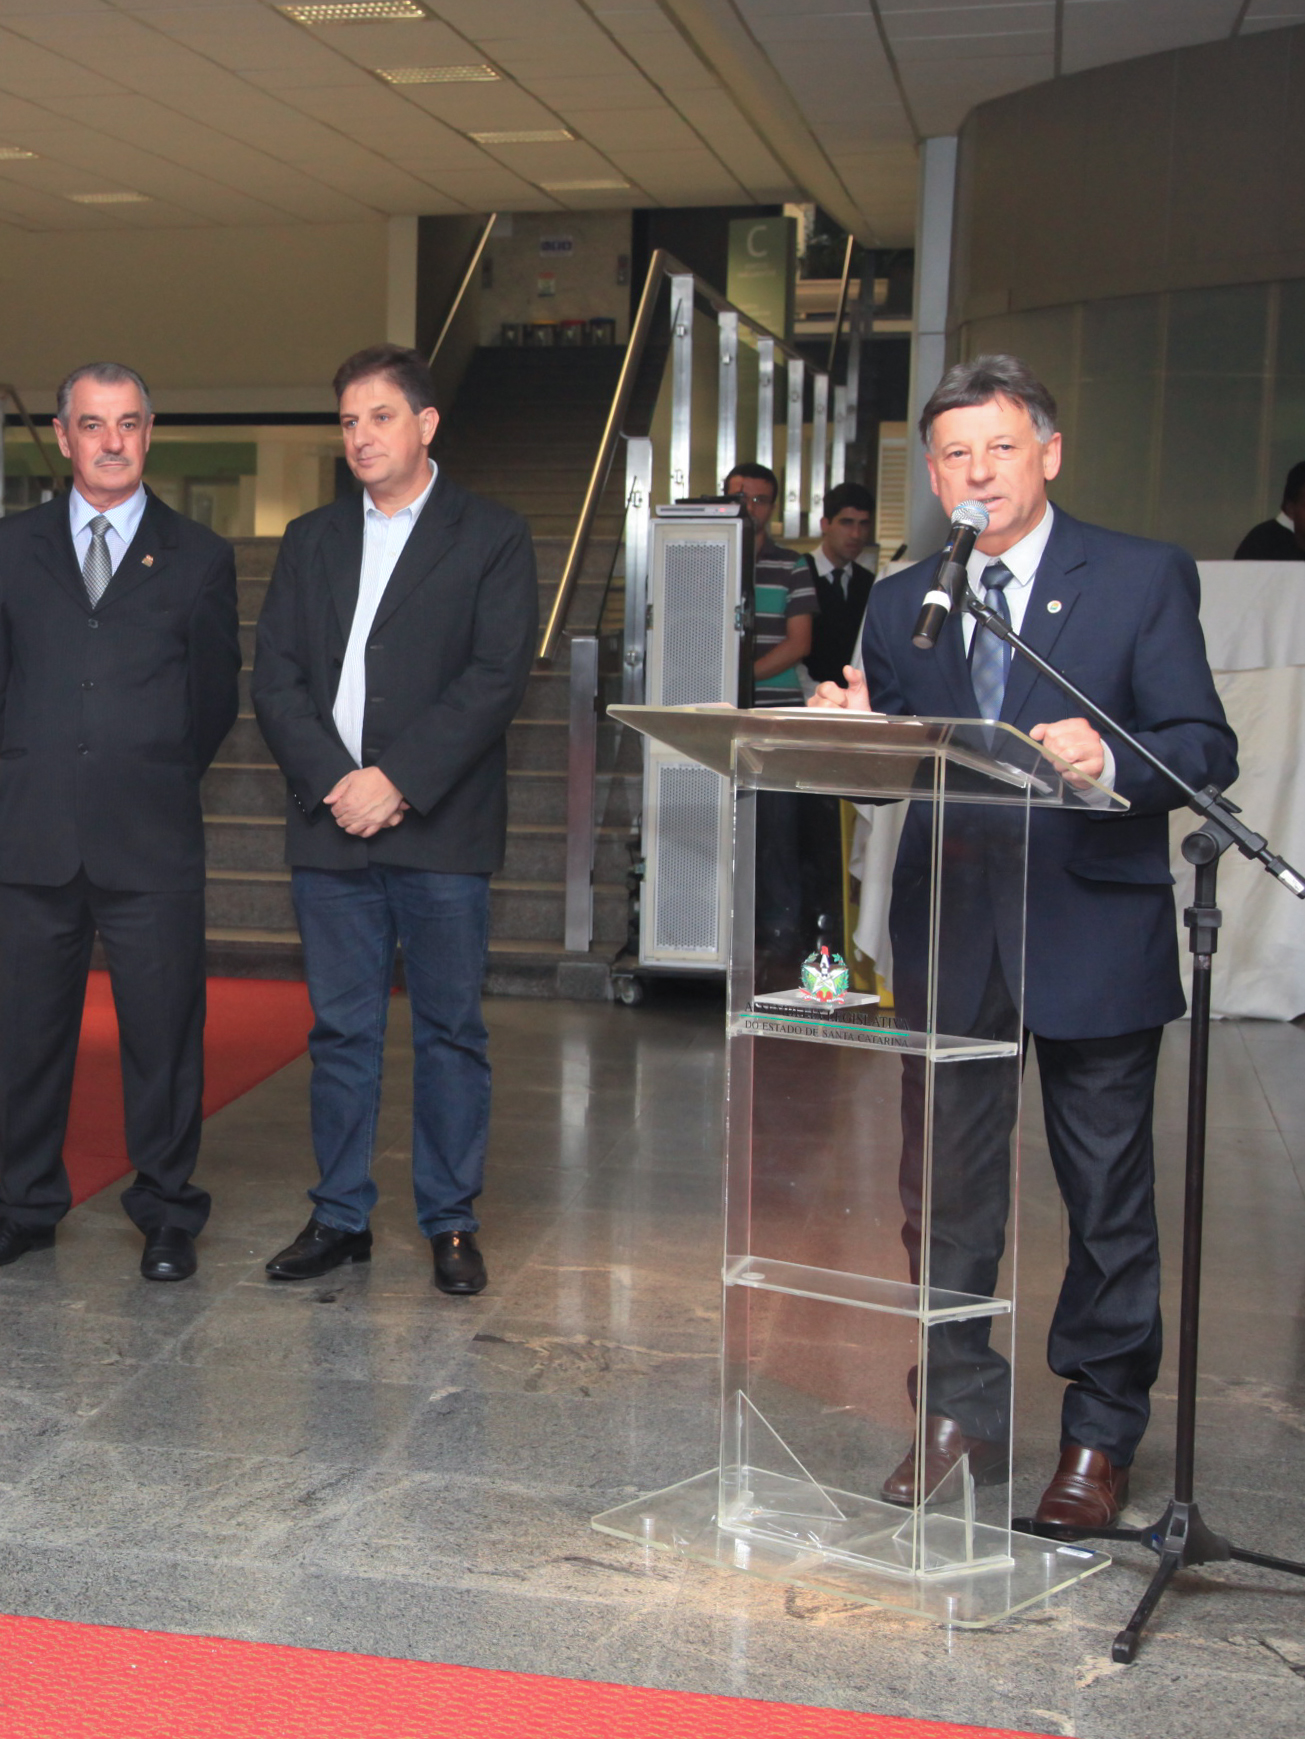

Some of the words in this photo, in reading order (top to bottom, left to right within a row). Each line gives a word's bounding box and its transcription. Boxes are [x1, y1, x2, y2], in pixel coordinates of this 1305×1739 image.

[747, 224, 768, 258] C
[827, 1009, 909, 1030] LEGISLATIVA
[745, 1020, 759, 1029] DO
[762, 1022, 803, 1035] ESTADO
[805, 1026, 818, 1037] DE
[822, 1029, 854, 1042] SANTA
[857, 1034, 909, 1048] CATARINA
